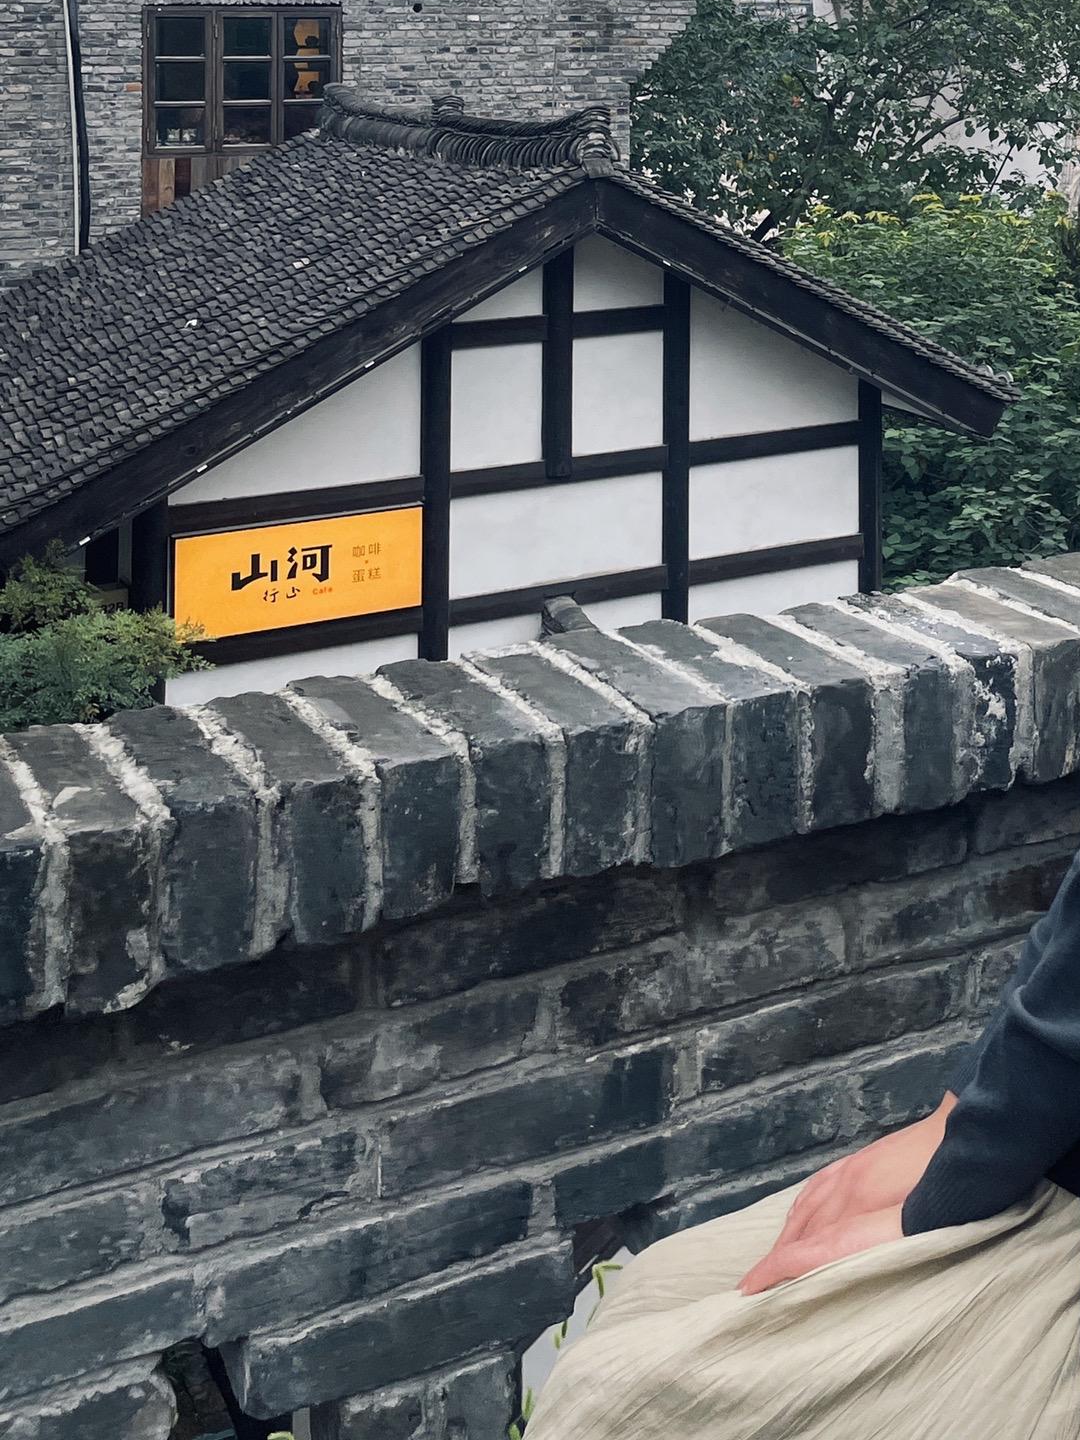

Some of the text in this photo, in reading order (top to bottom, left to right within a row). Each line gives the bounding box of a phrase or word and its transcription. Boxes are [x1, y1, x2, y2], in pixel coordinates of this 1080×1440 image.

[352, 542, 381, 558] 咖啡
[231, 544, 332, 591] 山河
[351, 567, 381, 583] 蛋糕
[312, 586, 332, 596] Cafe
